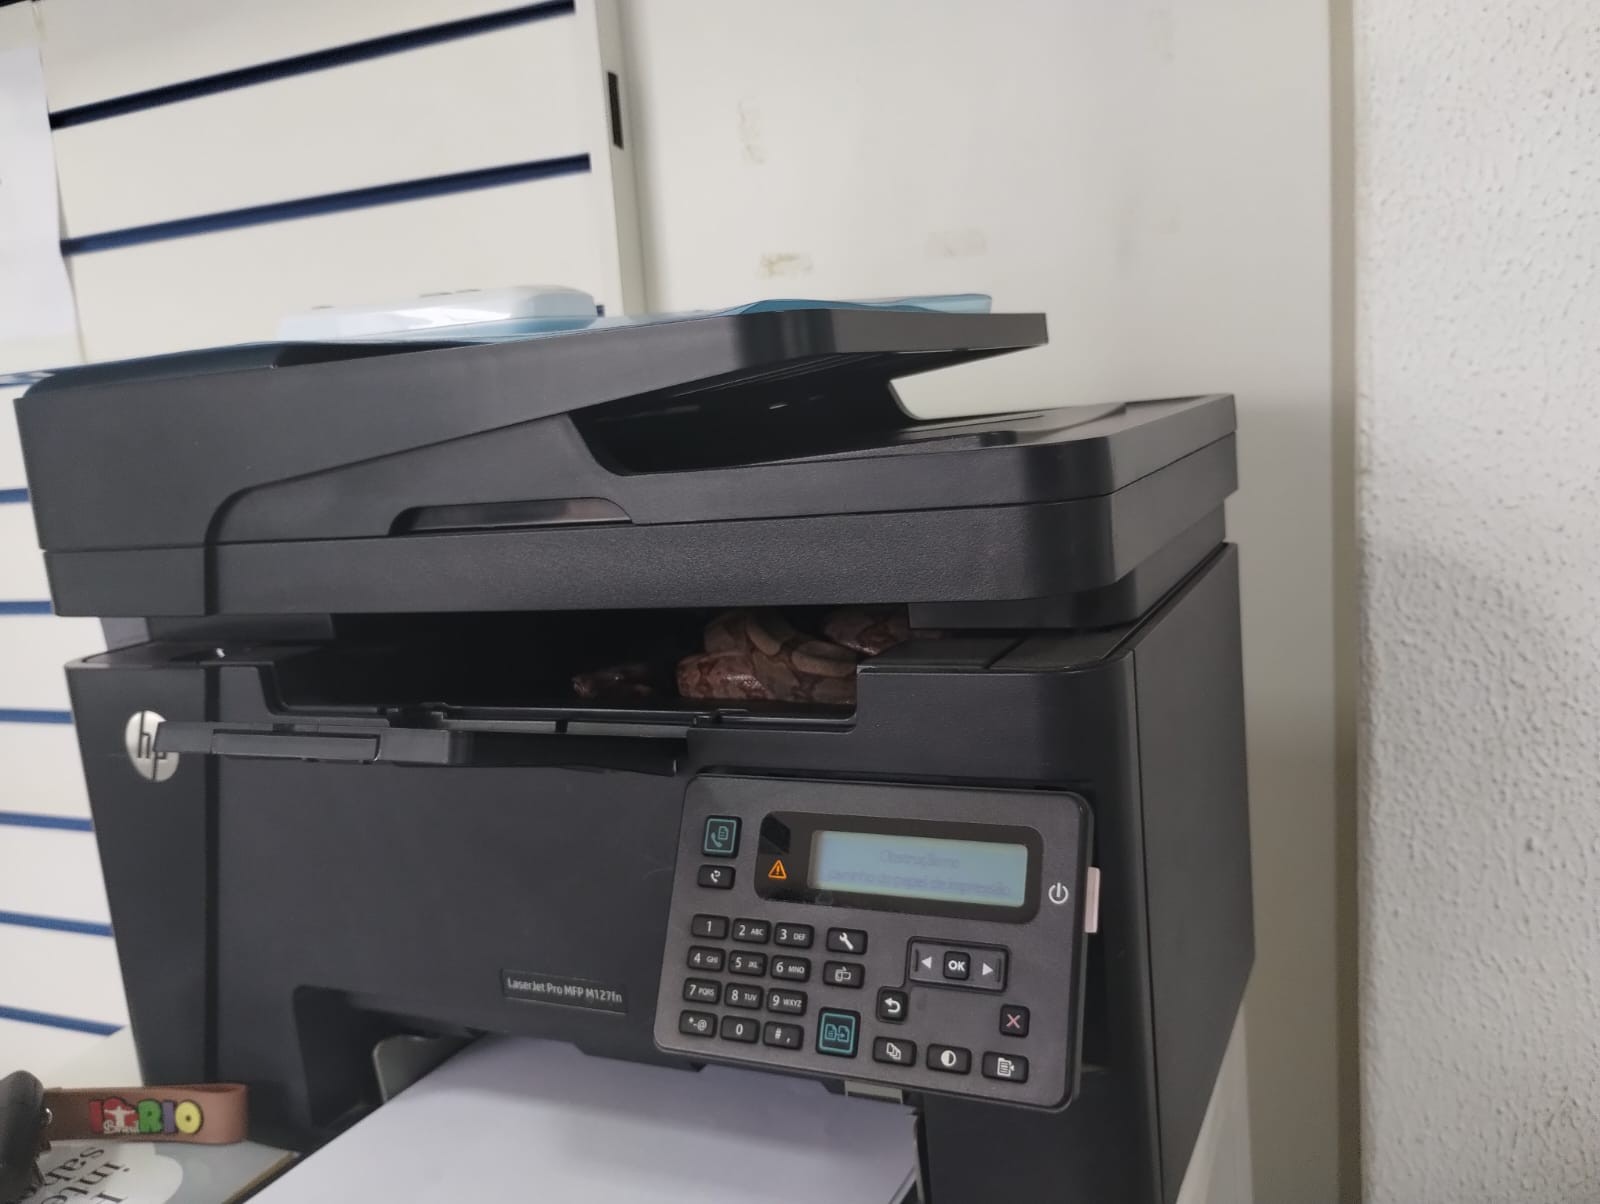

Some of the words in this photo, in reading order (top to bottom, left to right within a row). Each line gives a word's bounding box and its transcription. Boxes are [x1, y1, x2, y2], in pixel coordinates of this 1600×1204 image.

[706, 920, 712, 933] 1
[738, 924, 746, 936] 2
[750, 928, 765, 936] ABC
[779, 928, 788, 940] 3
[793, 932, 806, 941] DEF
[693, 952, 701, 964] 4
[735, 957, 742, 968] 5
[776, 961, 784, 973] 6
[788, 965, 805, 974] MNO
[948, 960, 966, 972] OK
[507, 977, 546, 993] LaserJet
[546, 982, 563, 995] Pro
[564, 984, 584, 998] MFP
[689, 984, 697, 996] 7
[731, 989, 739, 1001] 8
[744, 993, 757, 1001] TUV
[772, 995, 780, 1006] 9
[735, 1023, 744, 1036] 0
[137, 1098, 203, 1135] RIO
